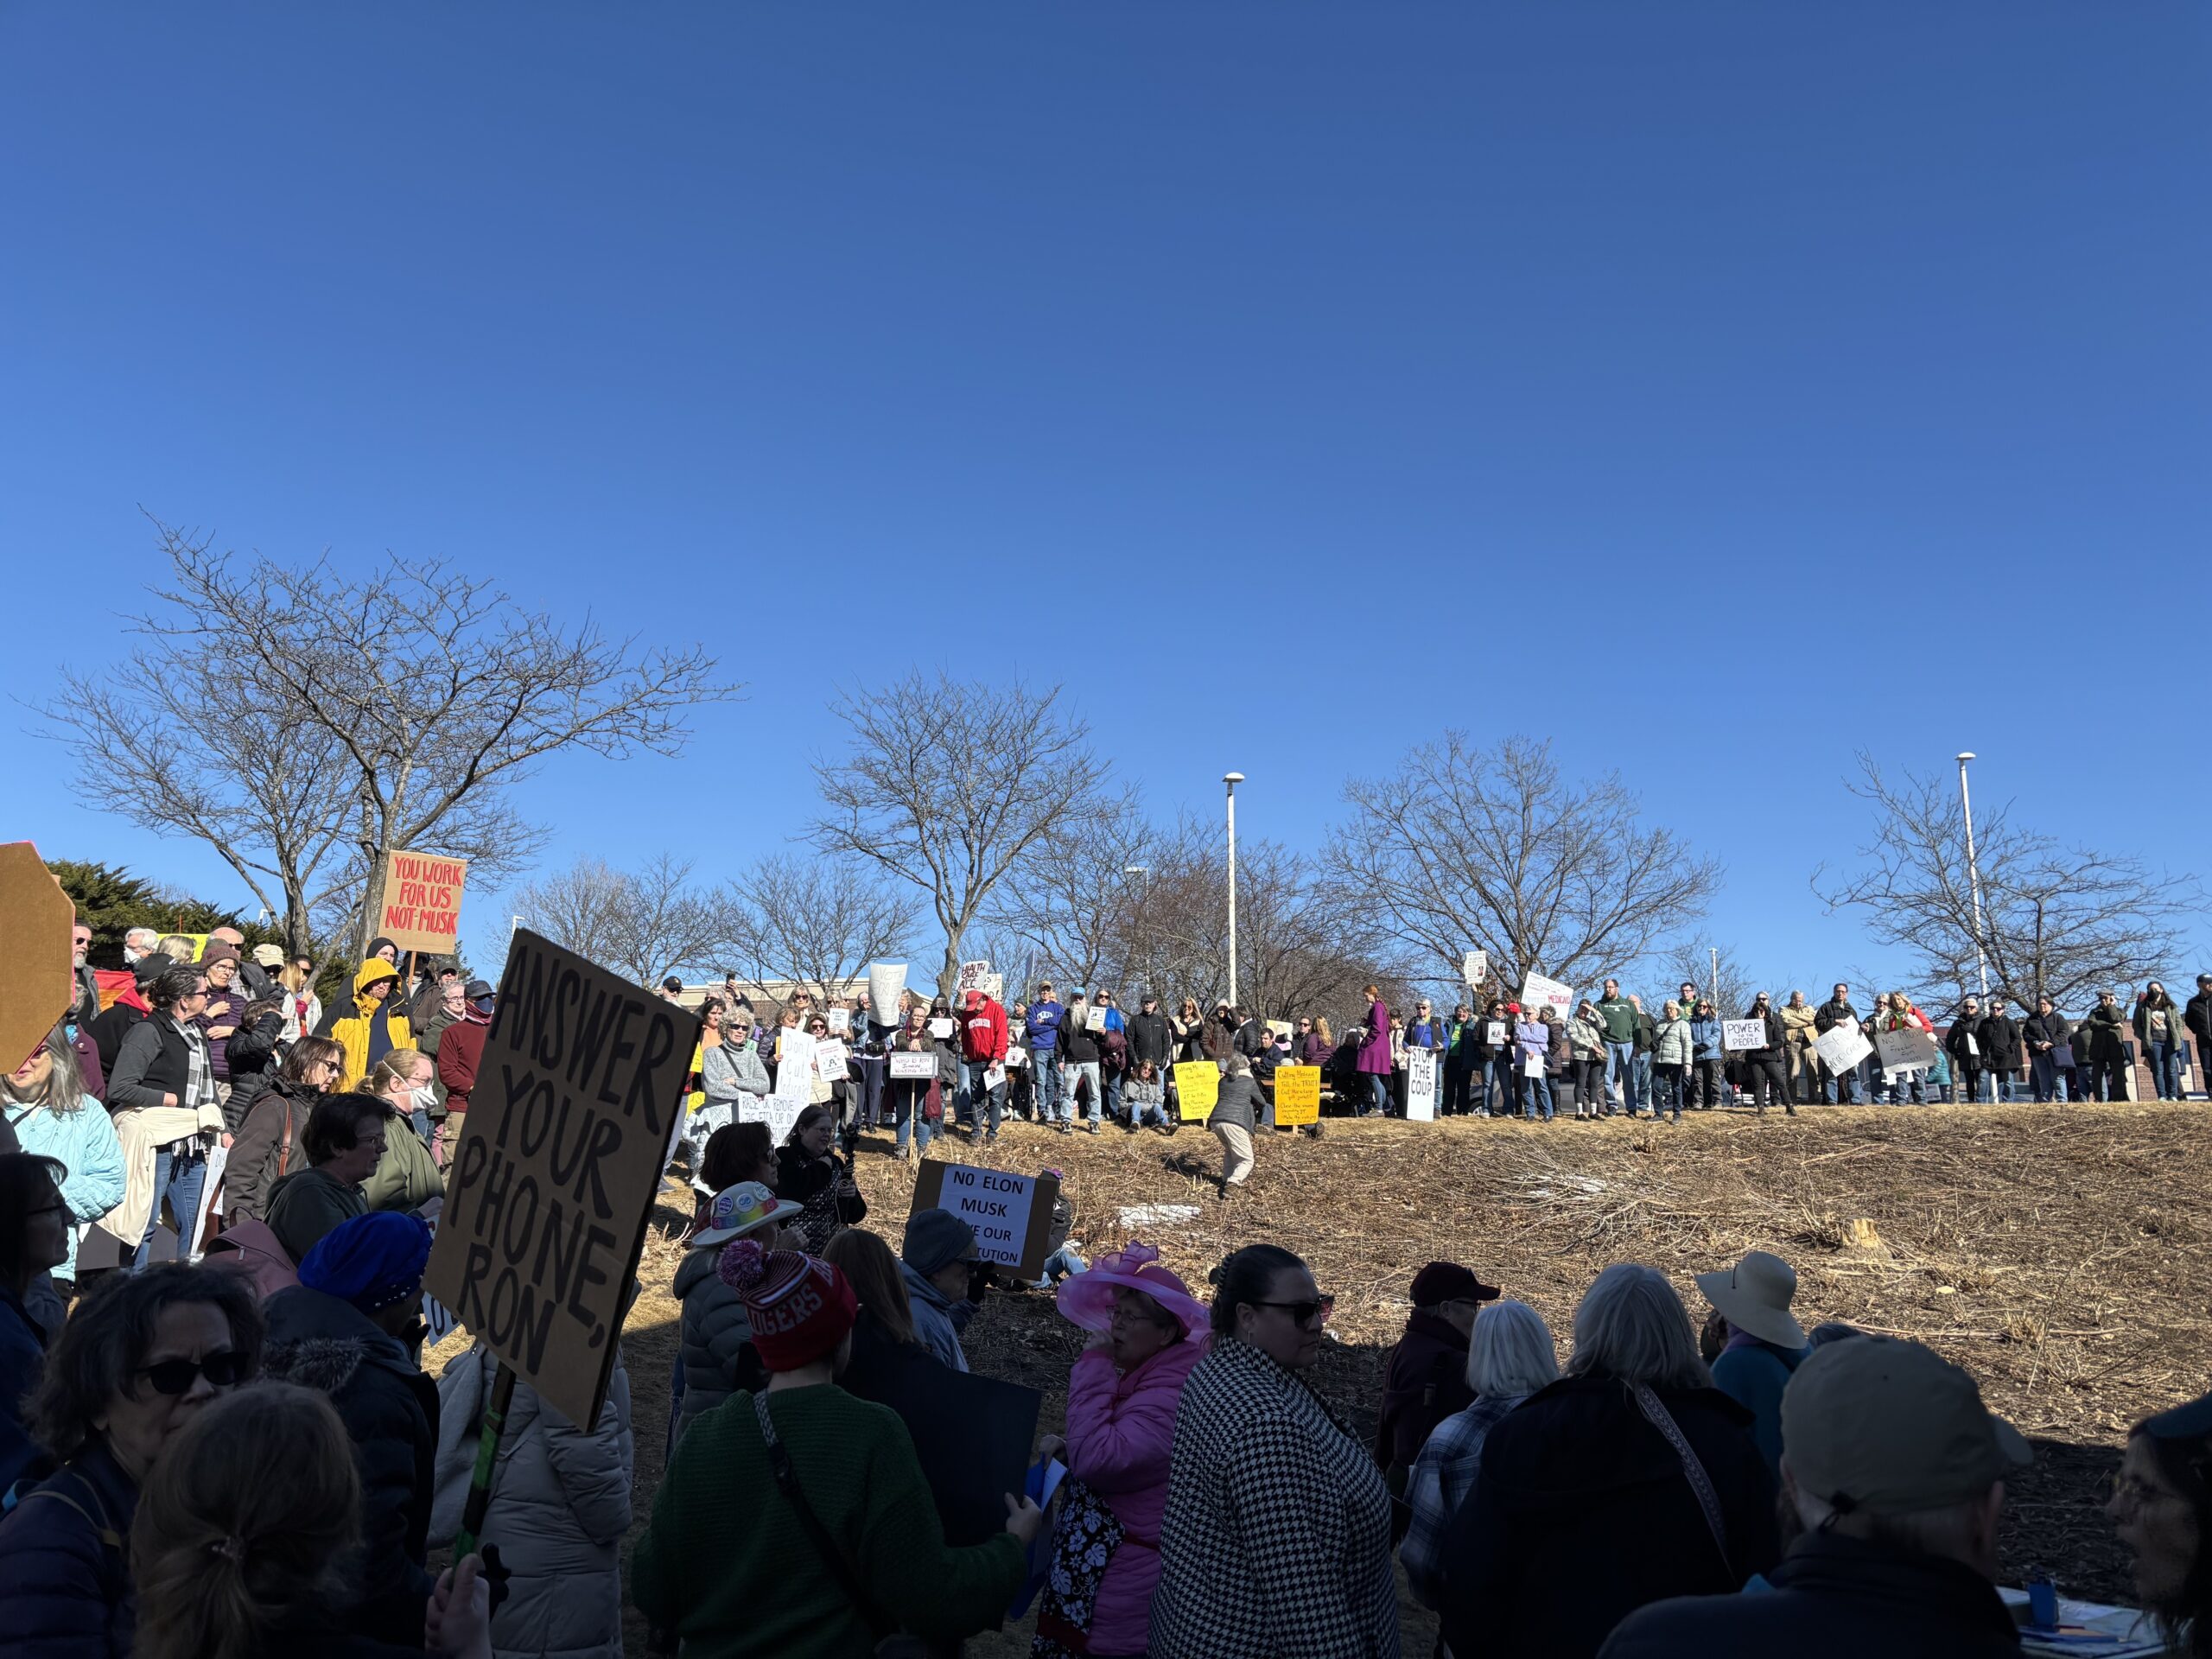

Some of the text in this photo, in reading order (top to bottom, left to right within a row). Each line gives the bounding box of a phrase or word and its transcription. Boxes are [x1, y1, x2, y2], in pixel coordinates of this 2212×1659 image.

[395, 856, 462, 887] YOU WORK
[399, 881, 451, 909] FOR US
[385, 906, 457, 935] NOT MUSK
[962, 963, 985, 974] HEALTH
[1548, 995, 1571, 1004] MEDICAID
[1727, 1022, 1760, 1035] POWER
[490, 945, 674, 1135] ANSWER
[1732, 1037, 1760, 1046] PEOPLE
[1881, 1036, 1895, 1045] NO
[1413, 1048, 1433, 1064] STOP
[786, 1058, 805, 1079] Cut
[1414, 1064, 1430, 1080] THE
[1411, 1079, 1432, 1096] COUP
[772, 1097, 795, 1112] REMOVE
[497, 1065, 622, 1219] YOUR
[982, 1176, 1024, 1195] ELON
[961, 1198, 1007, 1217] MUSK
[448, 1135, 616, 1348] PHONE,
[983, 1227, 1012, 1242] OUR
[977, 1247, 1018, 1262] TUTION
[457, 1243, 556, 1376] RON
[753, 1282, 823, 1335] DGERS
